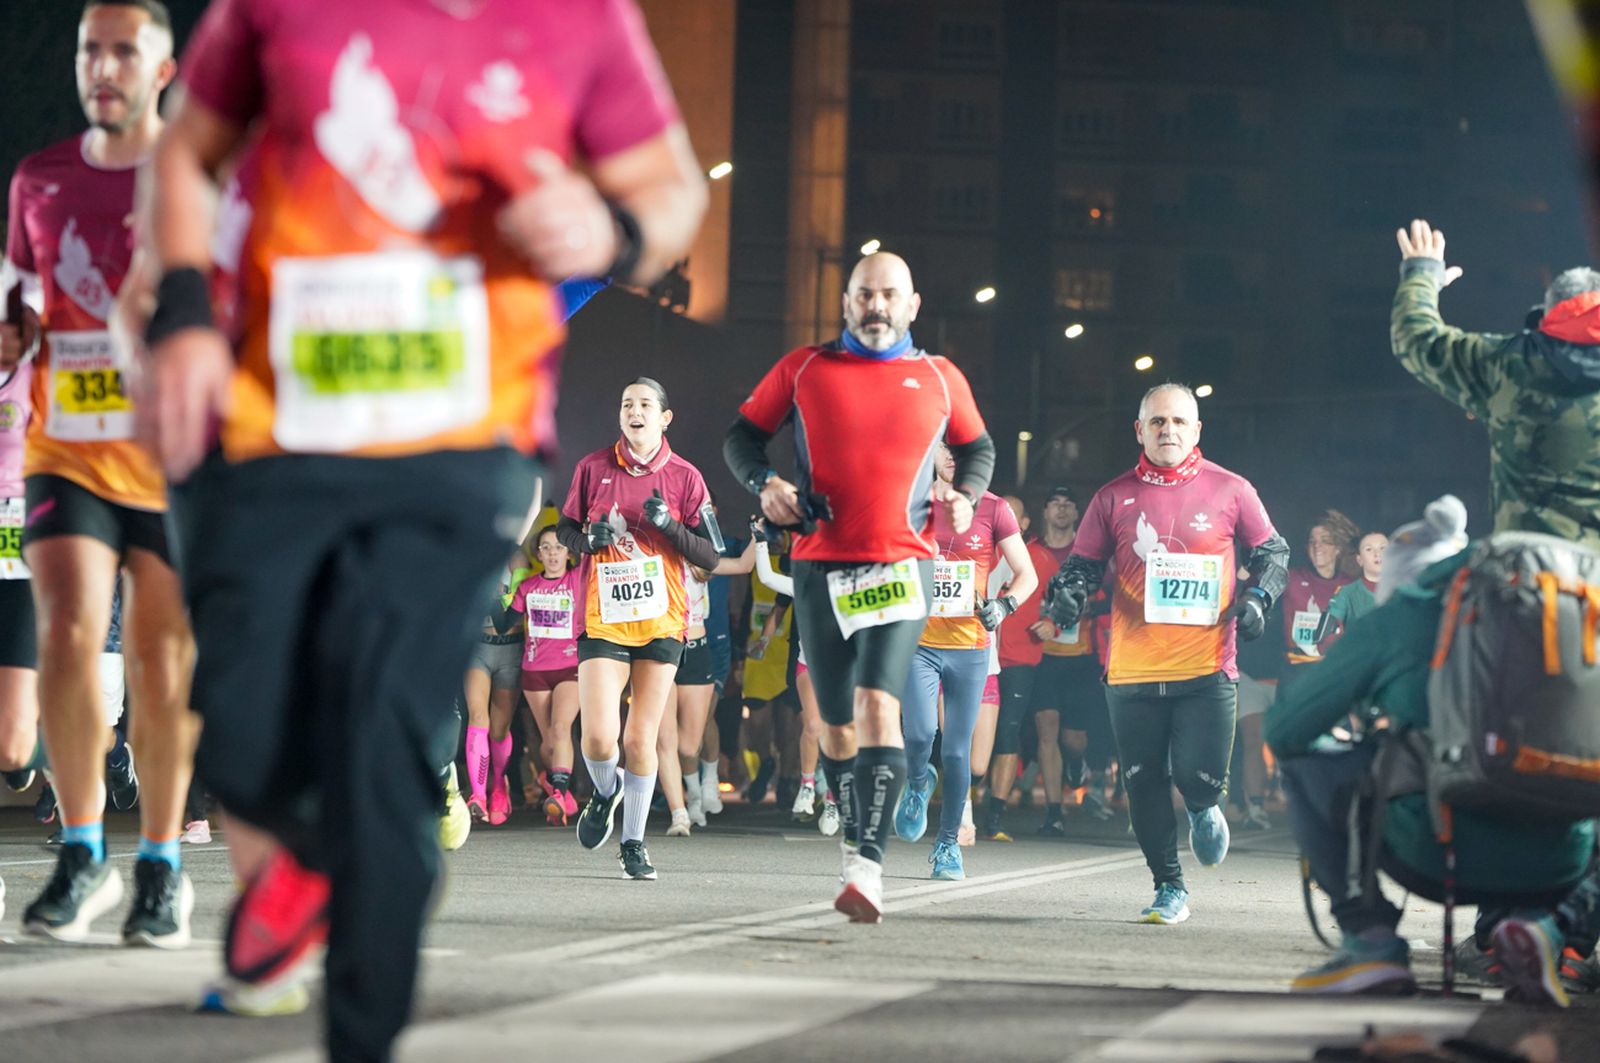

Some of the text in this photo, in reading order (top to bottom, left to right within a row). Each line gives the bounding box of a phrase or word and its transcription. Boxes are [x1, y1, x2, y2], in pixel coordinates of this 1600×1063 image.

[617, 536, 634, 553] 43
[612, 580, 654, 601] 4029
[848, 581, 906, 609] 5650
[1160, 579, 1210, 600] 12774
